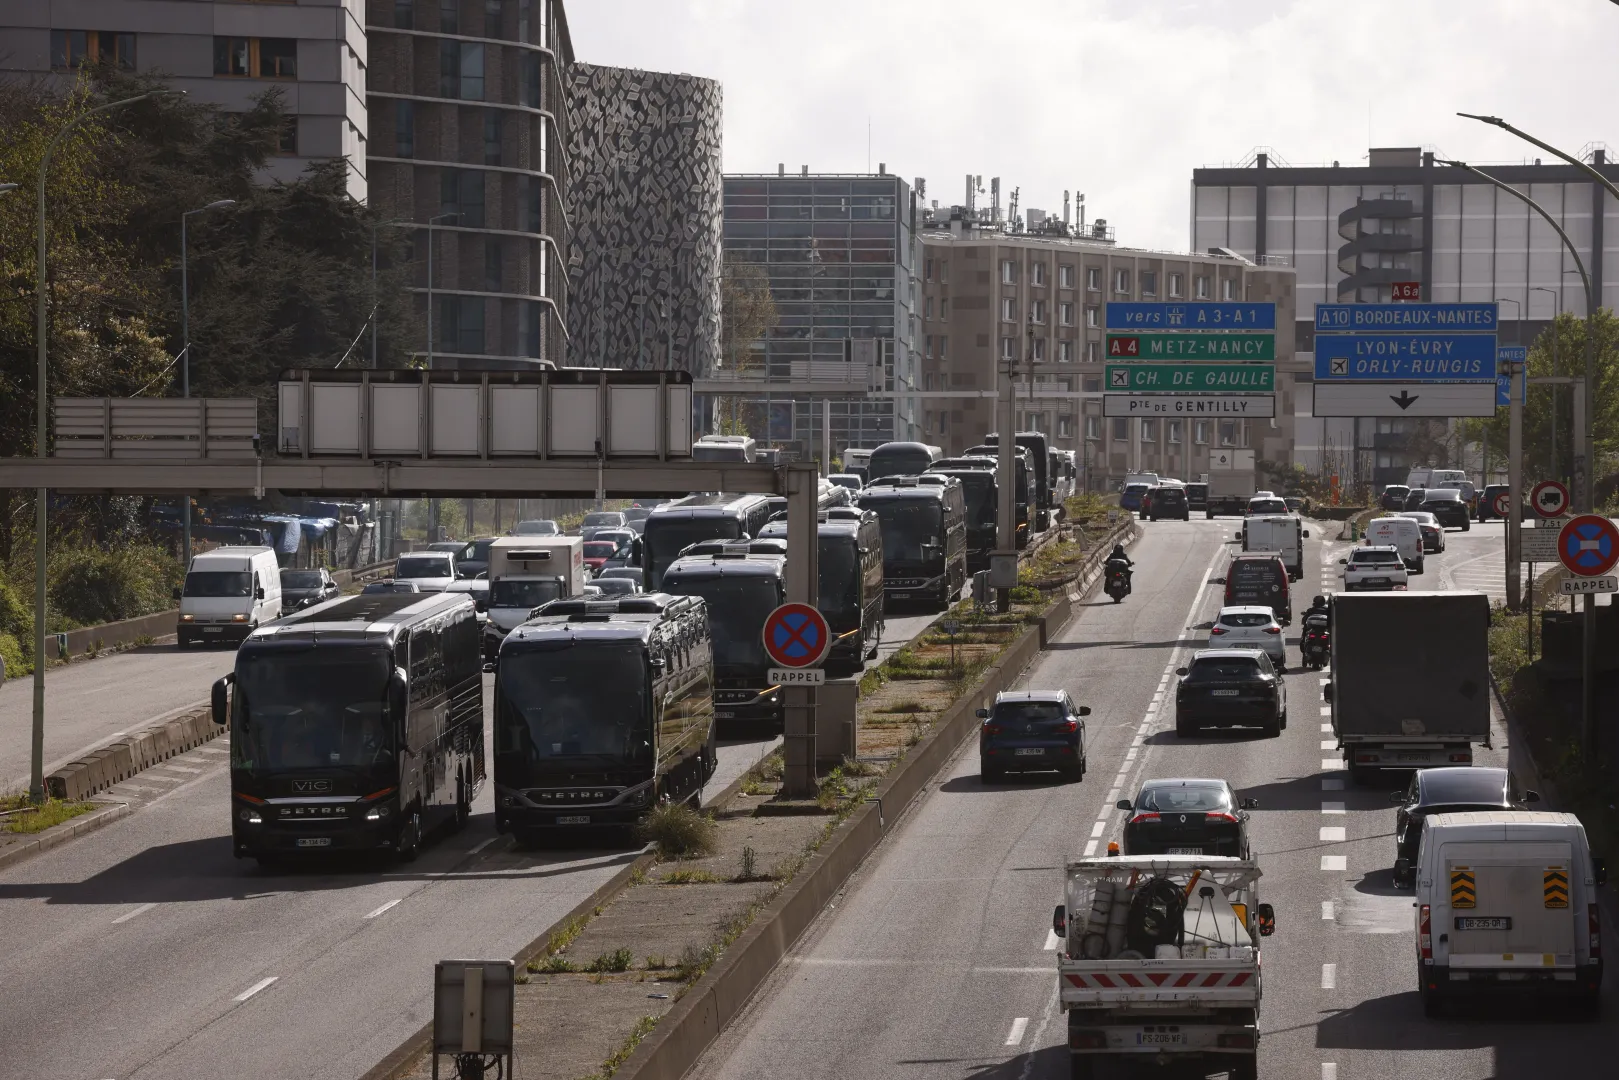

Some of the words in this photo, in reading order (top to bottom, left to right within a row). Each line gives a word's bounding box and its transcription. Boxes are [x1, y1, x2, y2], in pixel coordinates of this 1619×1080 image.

[1125, 311, 1161, 323] vers
[1355, 310, 1493, 324] BORDEAUX-NANTES
[1151, 340, 1265, 354] METZ-NANCY
[1356, 338, 1454, 355] LYON-ÉVRY
[1498, 350, 1525, 359] ANTES
[1356, 359, 1482, 373] ORLY-RUNGIS
[1135, 371, 1161, 385] CH.
[1172, 371, 1195, 385] DE
[1205, 371, 1270, 385] GAULLE
[1154, 404, 1167, 412] DE
[1175, 400, 1248, 412] GENTILLY
[1564, 580, 1613, 592] RAPPEL
[772, 672, 820, 682] RAPPEL
[541, 791, 604, 799] SETRA
[280, 805, 347, 815] SETRA
